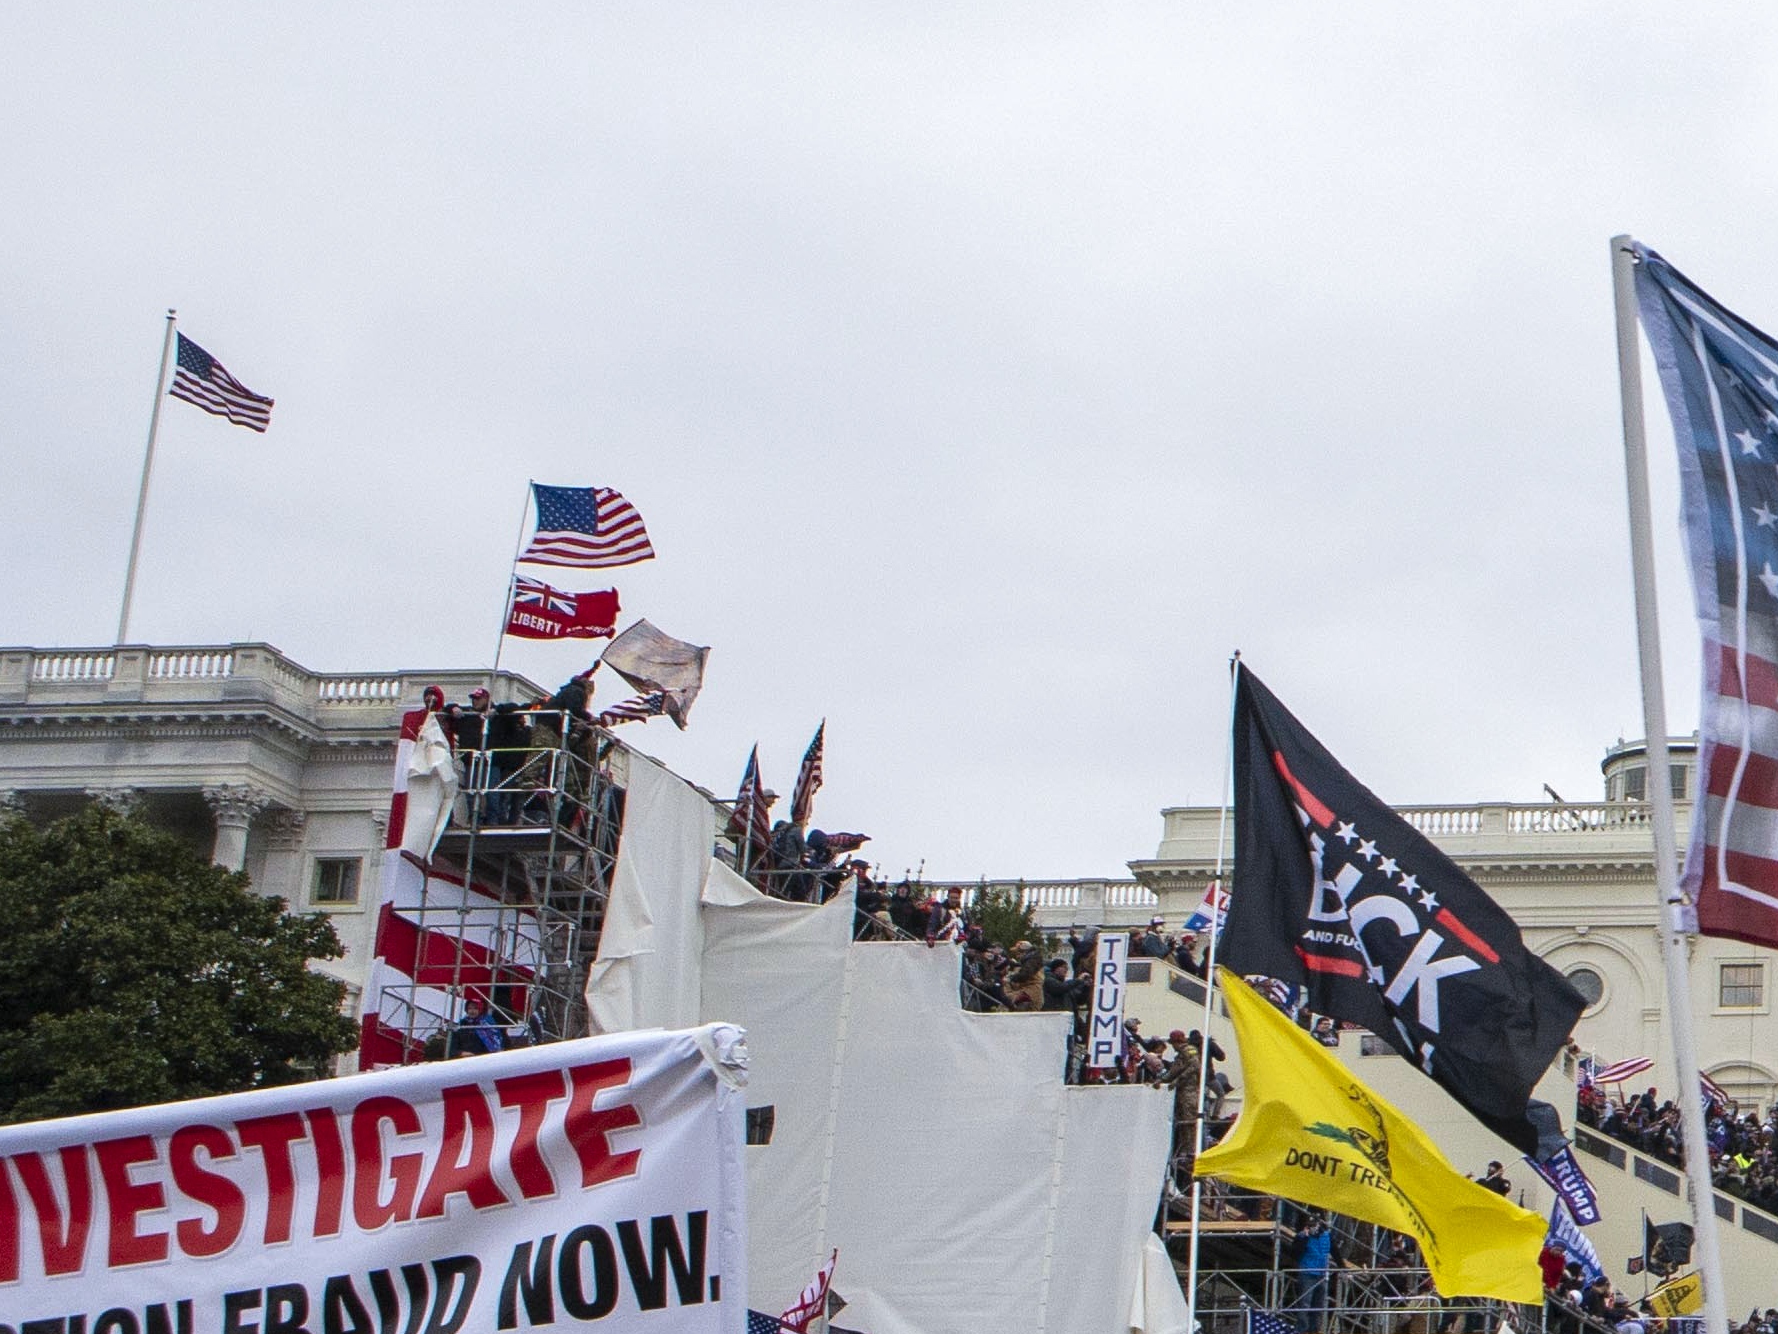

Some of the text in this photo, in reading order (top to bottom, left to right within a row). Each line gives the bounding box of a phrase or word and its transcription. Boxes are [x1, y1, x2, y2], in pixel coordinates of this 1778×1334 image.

[511, 610, 562, 636] LIBERTY
[1302, 929, 1333, 944] AND
[1093, 938, 1122, 1066] TRUMP
[1285, 1147, 1343, 1177] DONT
[1553, 1149, 1595, 1221] TRUMP
[498, 1210, 721, 1331] NOW.
